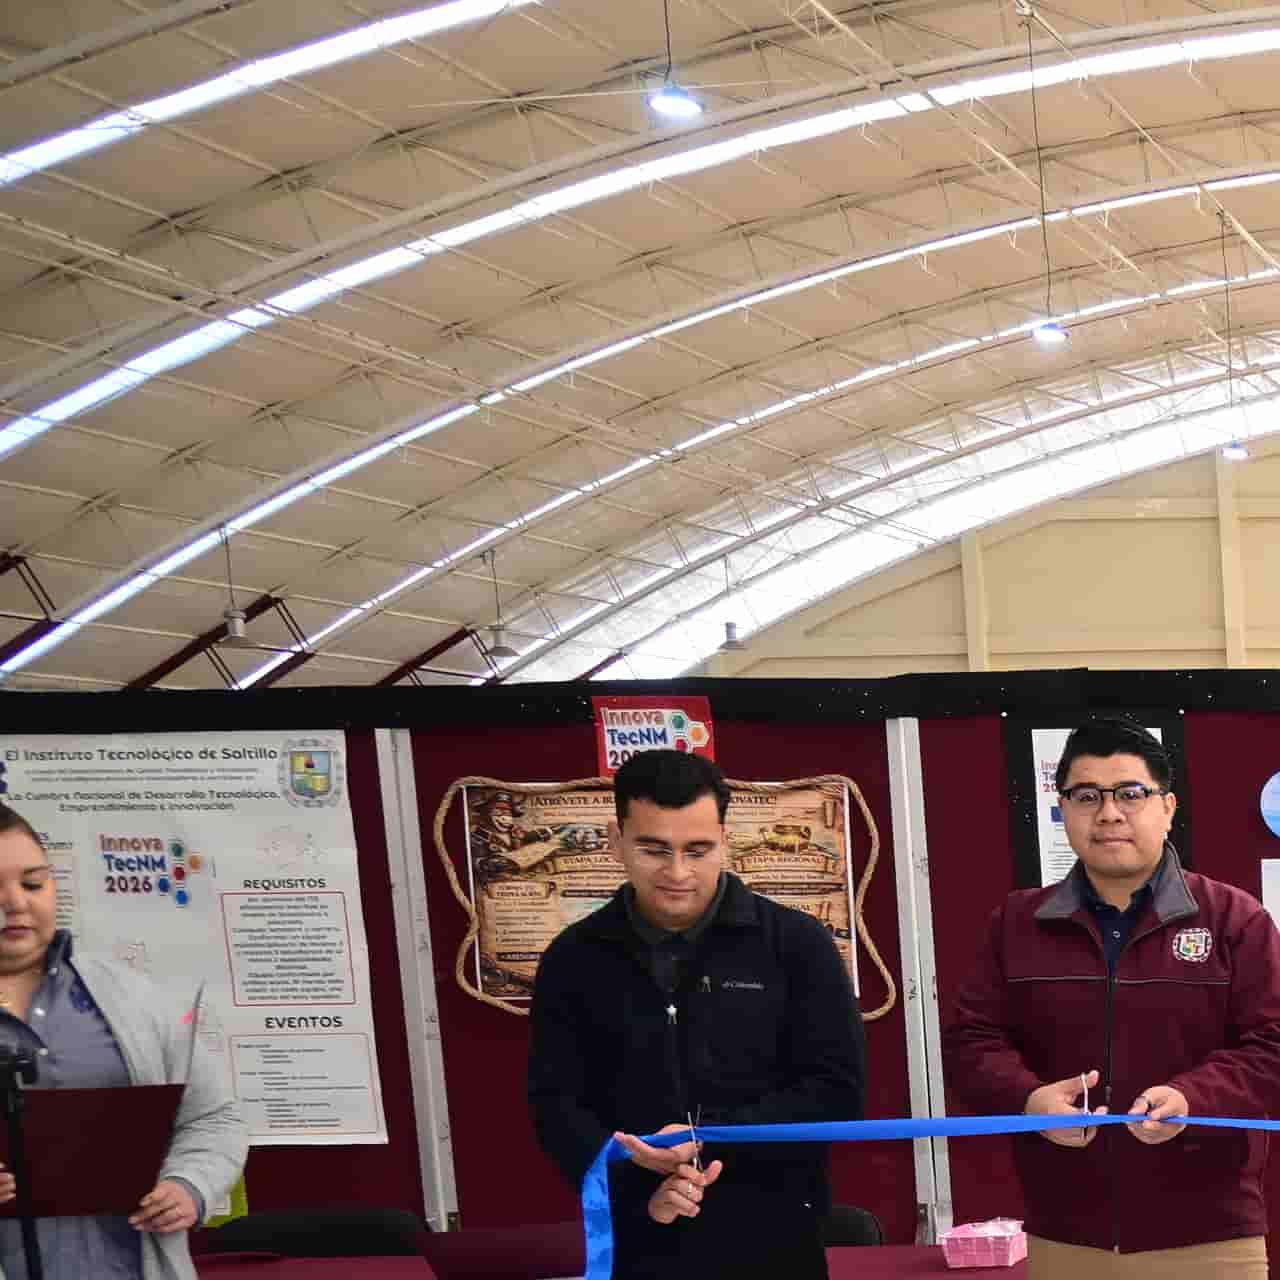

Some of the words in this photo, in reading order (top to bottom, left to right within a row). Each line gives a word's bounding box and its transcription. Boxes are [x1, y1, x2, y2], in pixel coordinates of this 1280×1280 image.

[607, 727, 668, 746] TecNM
[23, 749, 94, 761] Instituto
[198, 748, 218, 760] de
[221, 747, 278, 761] Saltillo
[103, 853, 167, 871] TecNM
[104, 875, 153, 893] 2026
[243, 878, 327, 890] REQUISITOS
[264, 1016, 343, 1029] EVENTOS
